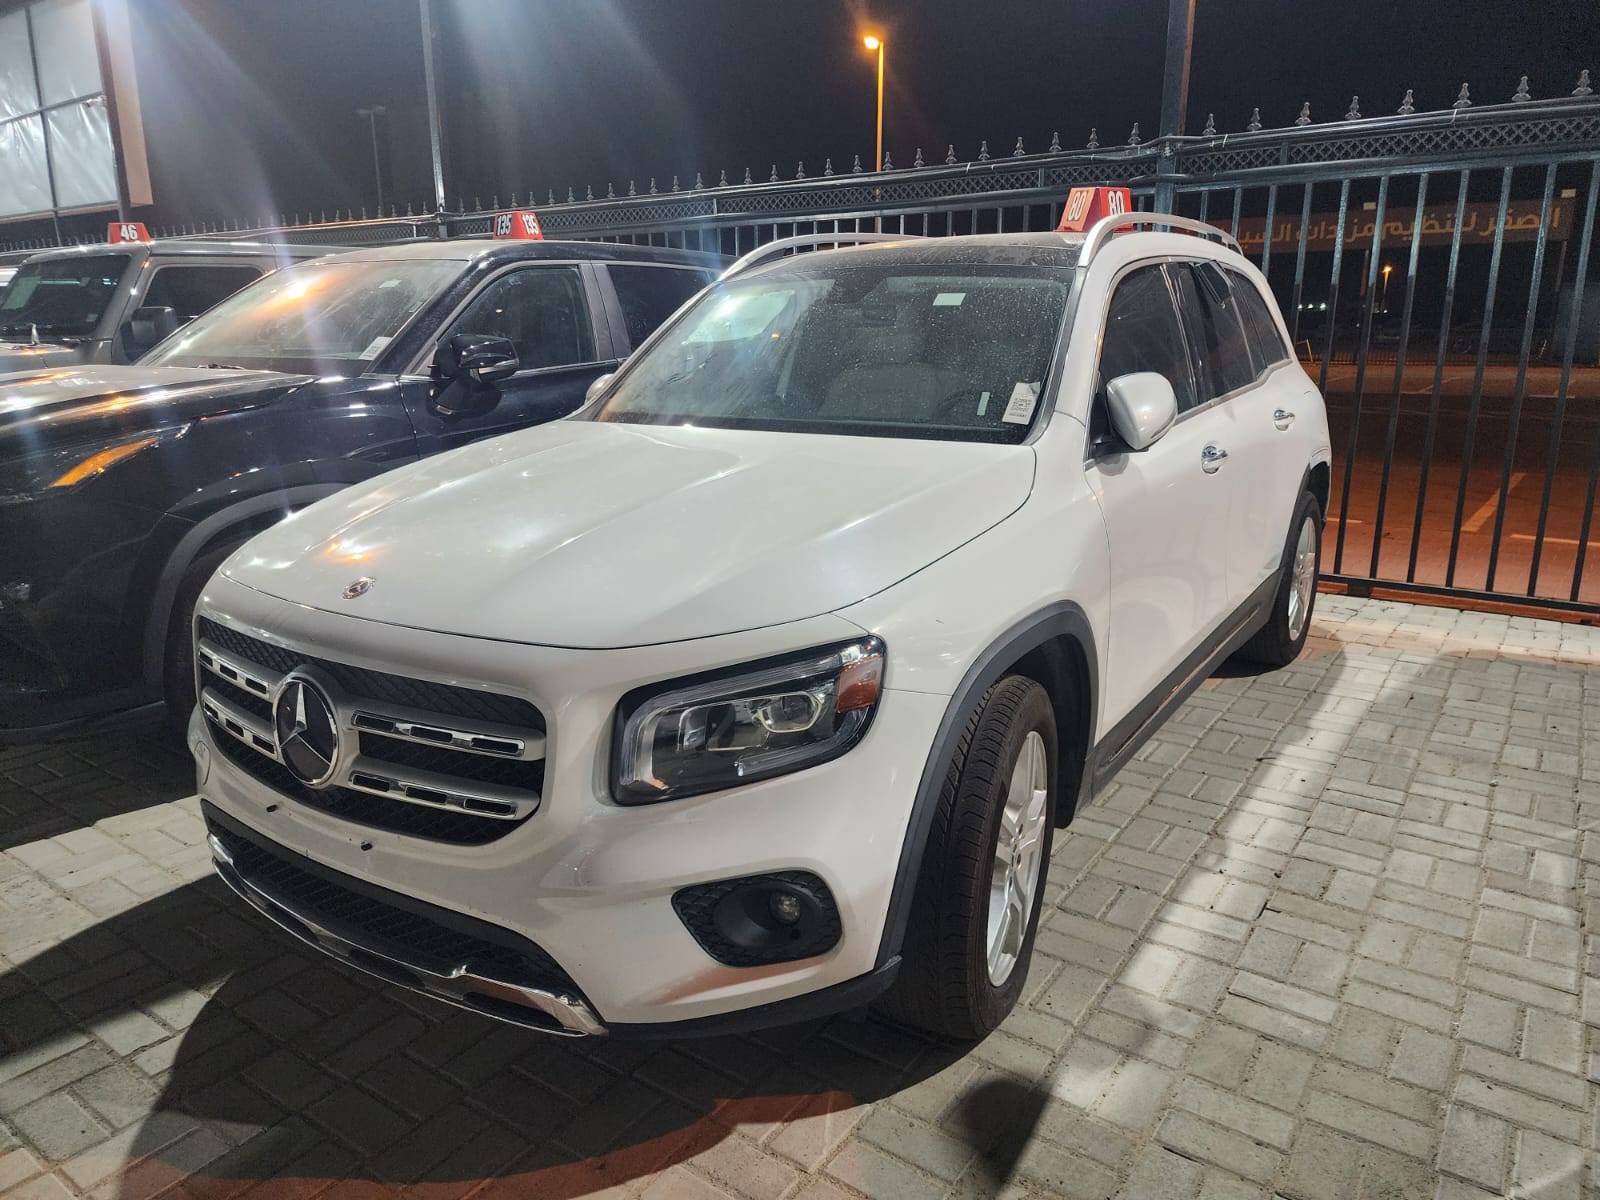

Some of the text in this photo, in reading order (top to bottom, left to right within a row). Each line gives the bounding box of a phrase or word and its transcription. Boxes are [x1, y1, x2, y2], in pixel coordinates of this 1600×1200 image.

[1068, 190, 1088, 221] 80
[120, 224, 138, 241] 46
[497, 213, 512, 236] 135
[521, 214, 539, 235] 135
